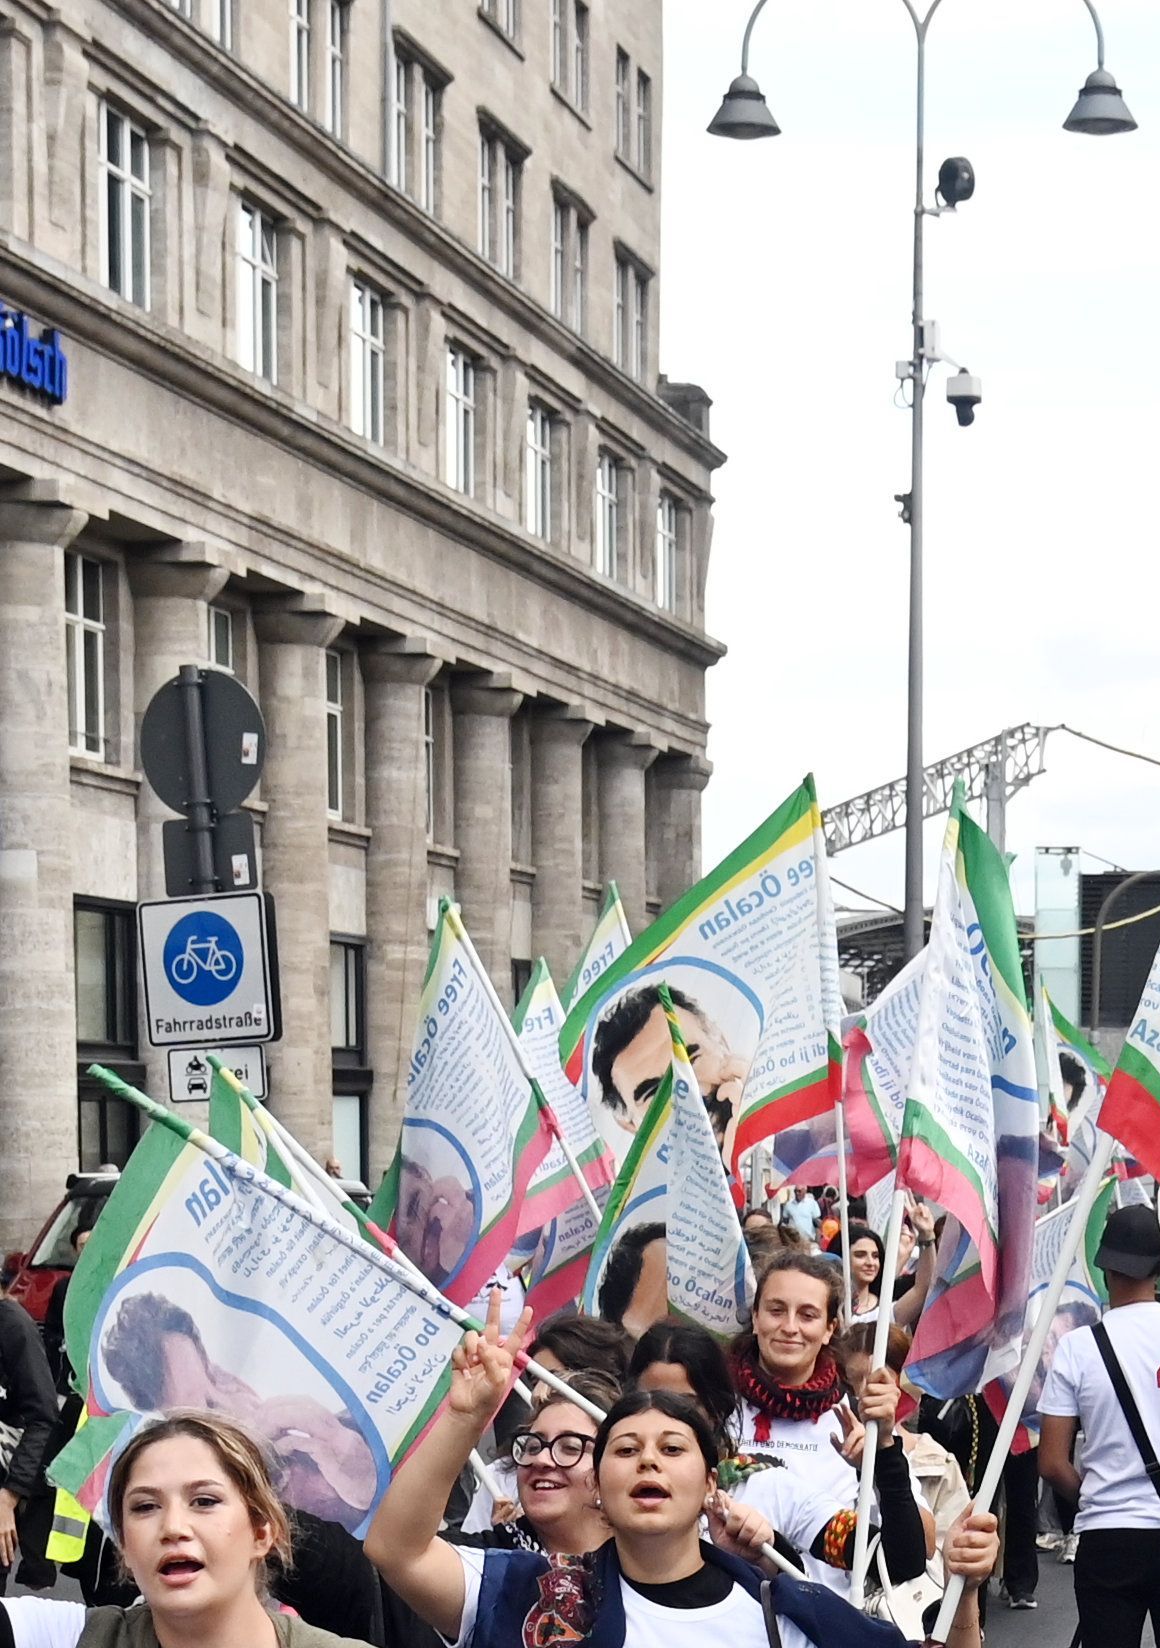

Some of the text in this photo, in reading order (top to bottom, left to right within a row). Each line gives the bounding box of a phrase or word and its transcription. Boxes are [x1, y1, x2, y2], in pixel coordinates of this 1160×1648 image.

[0, 299, 68, 402] ölsch
[155, 1011, 262, 1034] Fahrradstraße
[230, 1064, 249, 1080] ei
[889, 1089, 905, 1111] bo
[684, 1273, 732, 1310] Öcalan
